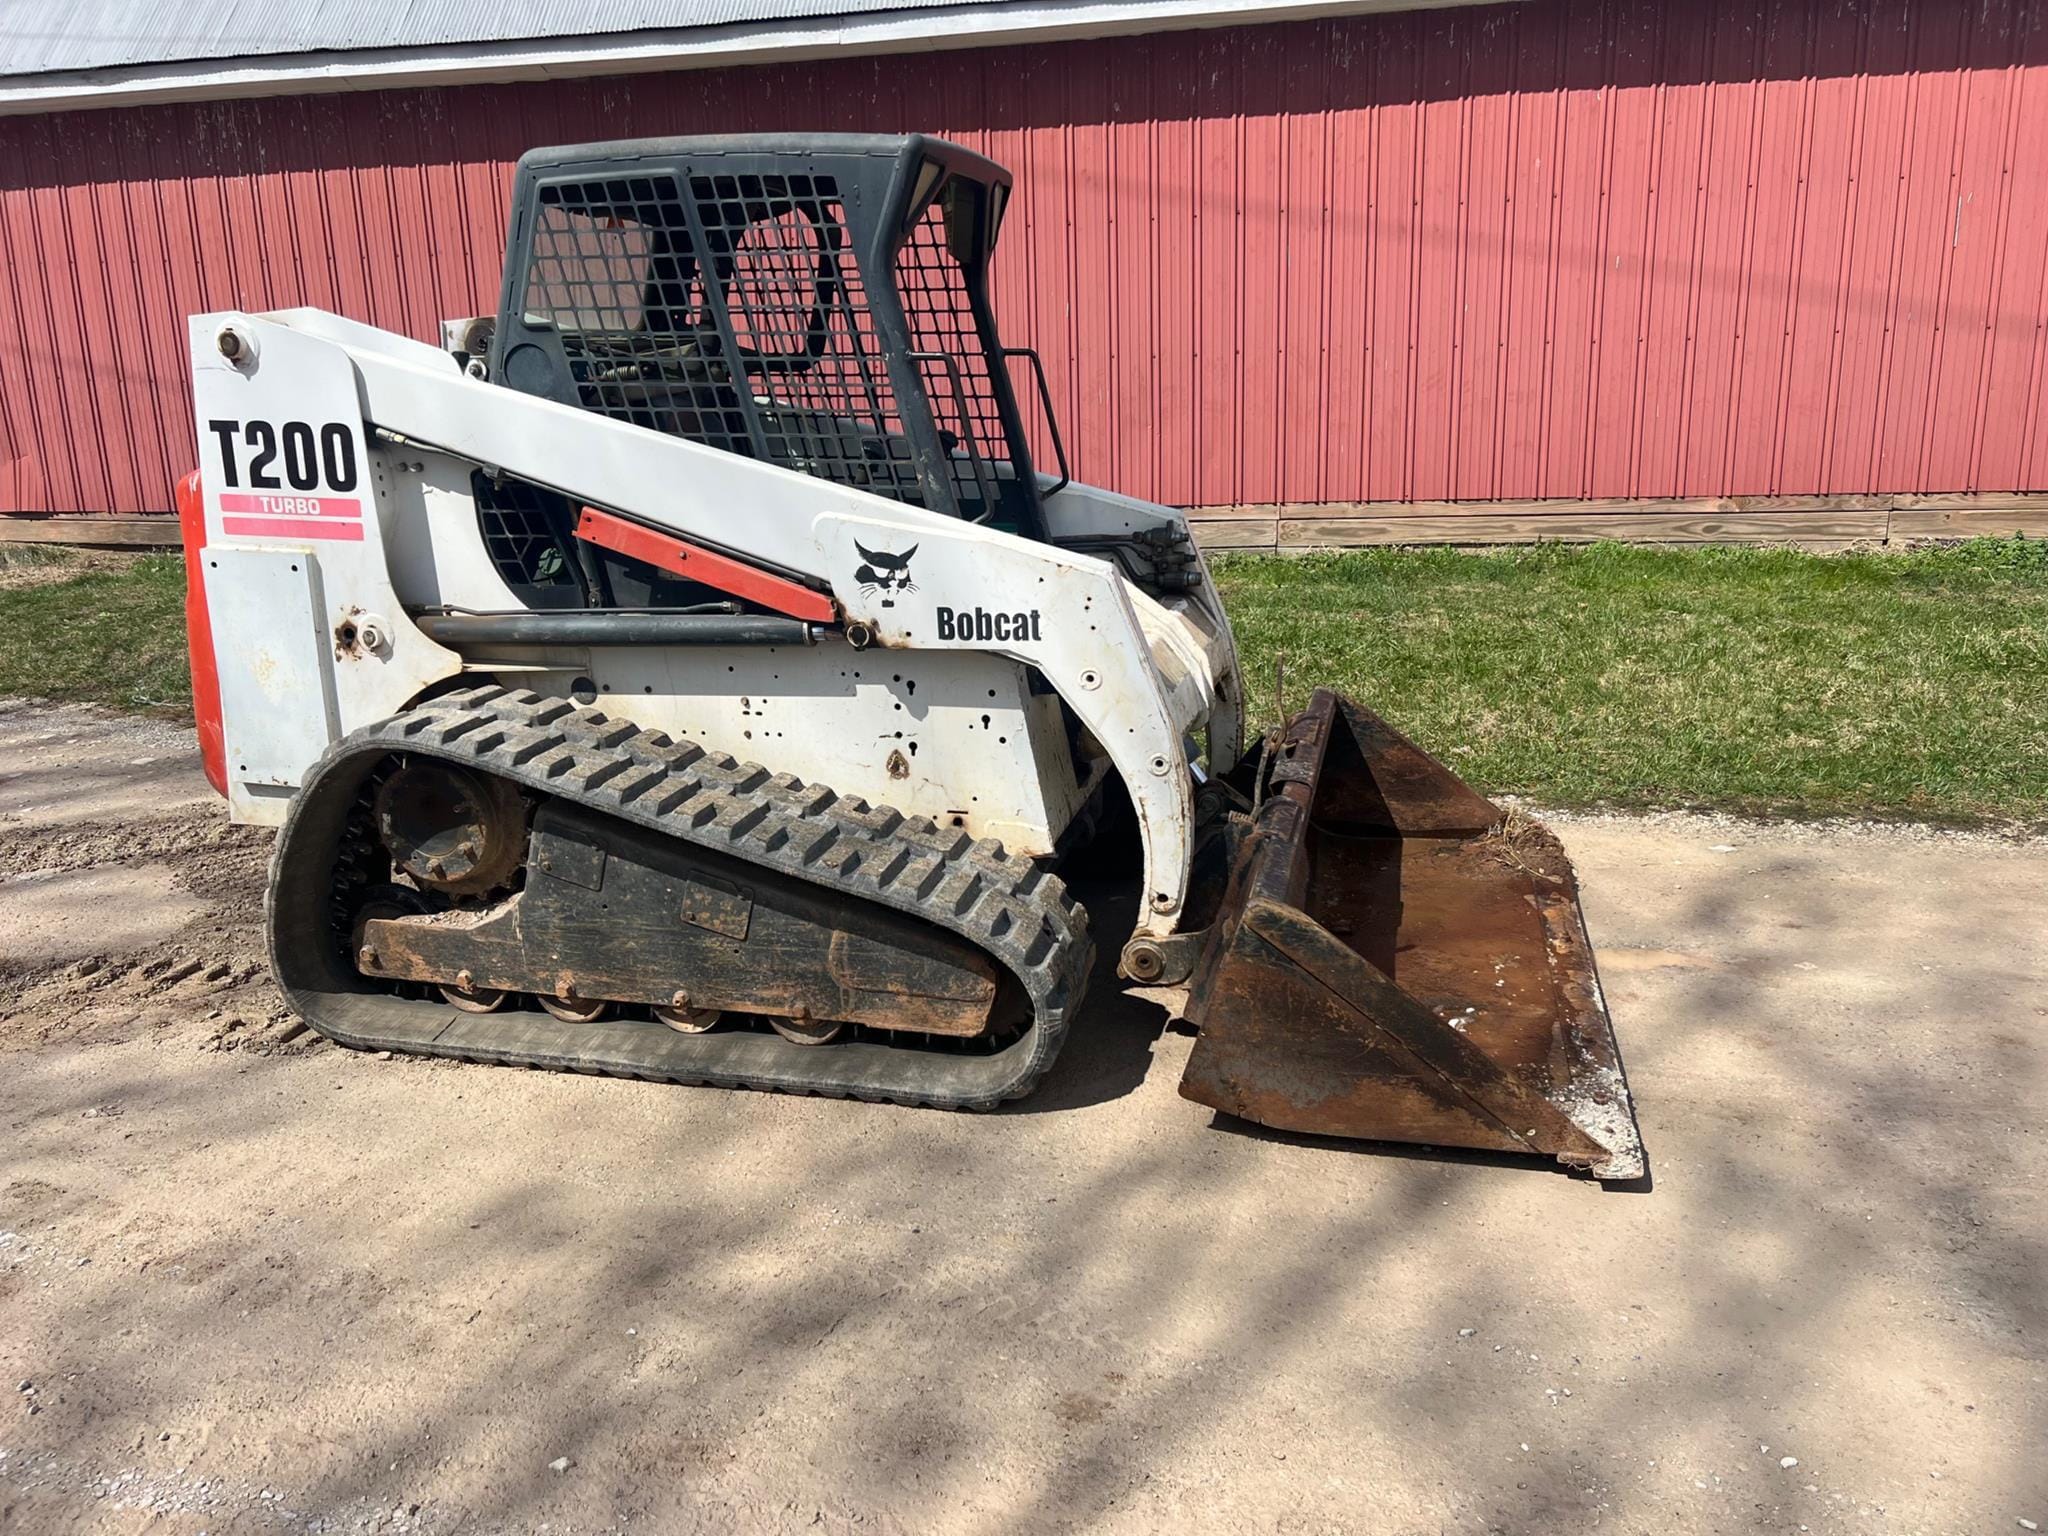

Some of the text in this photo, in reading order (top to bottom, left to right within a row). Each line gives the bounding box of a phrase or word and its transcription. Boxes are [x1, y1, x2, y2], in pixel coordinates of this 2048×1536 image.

[209, 420, 357, 492] T200
[261, 497, 321, 515] TURBO
[937, 606, 1042, 641] Bobcat
